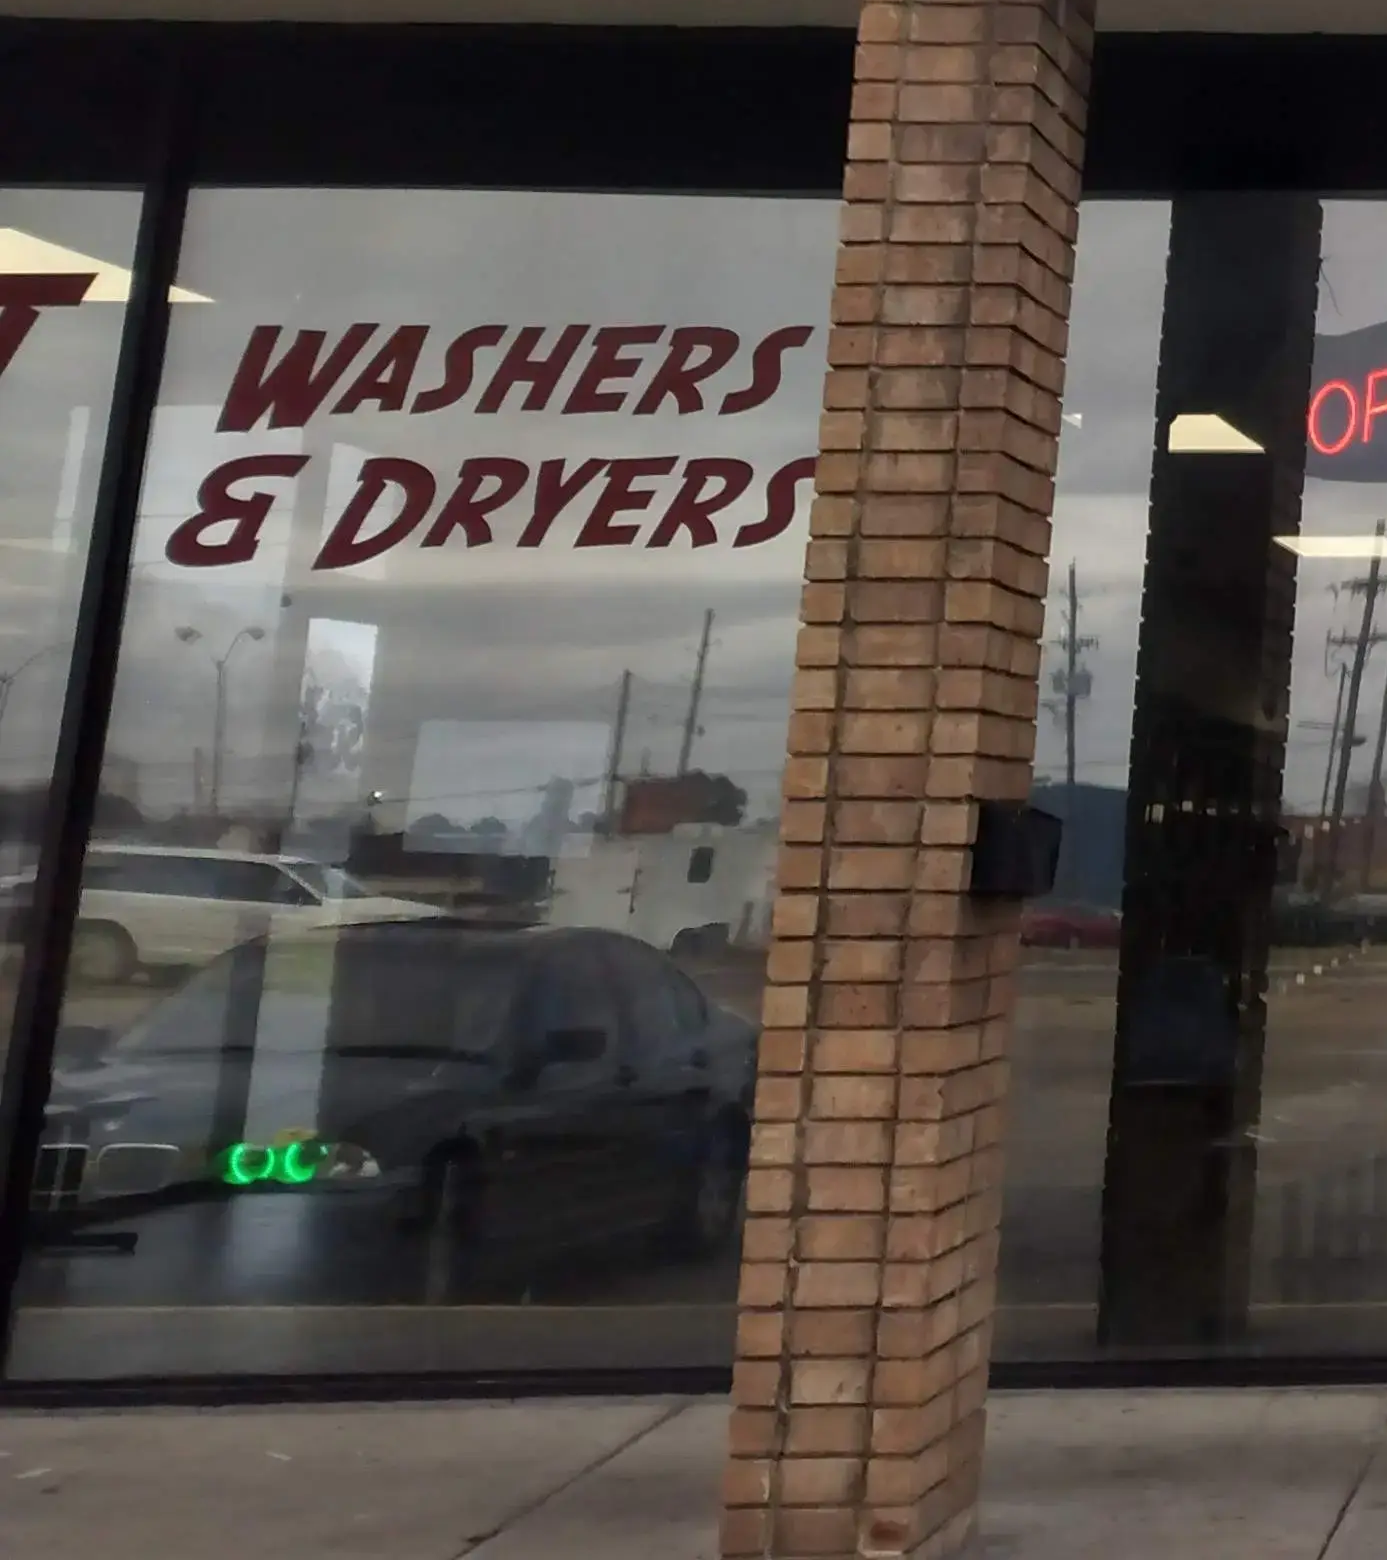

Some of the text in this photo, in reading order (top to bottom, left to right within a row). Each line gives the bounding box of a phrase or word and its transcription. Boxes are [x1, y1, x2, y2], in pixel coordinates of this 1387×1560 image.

[215, 323, 814, 433] WASHERS
[165, 454, 817, 569] & DRYERS
